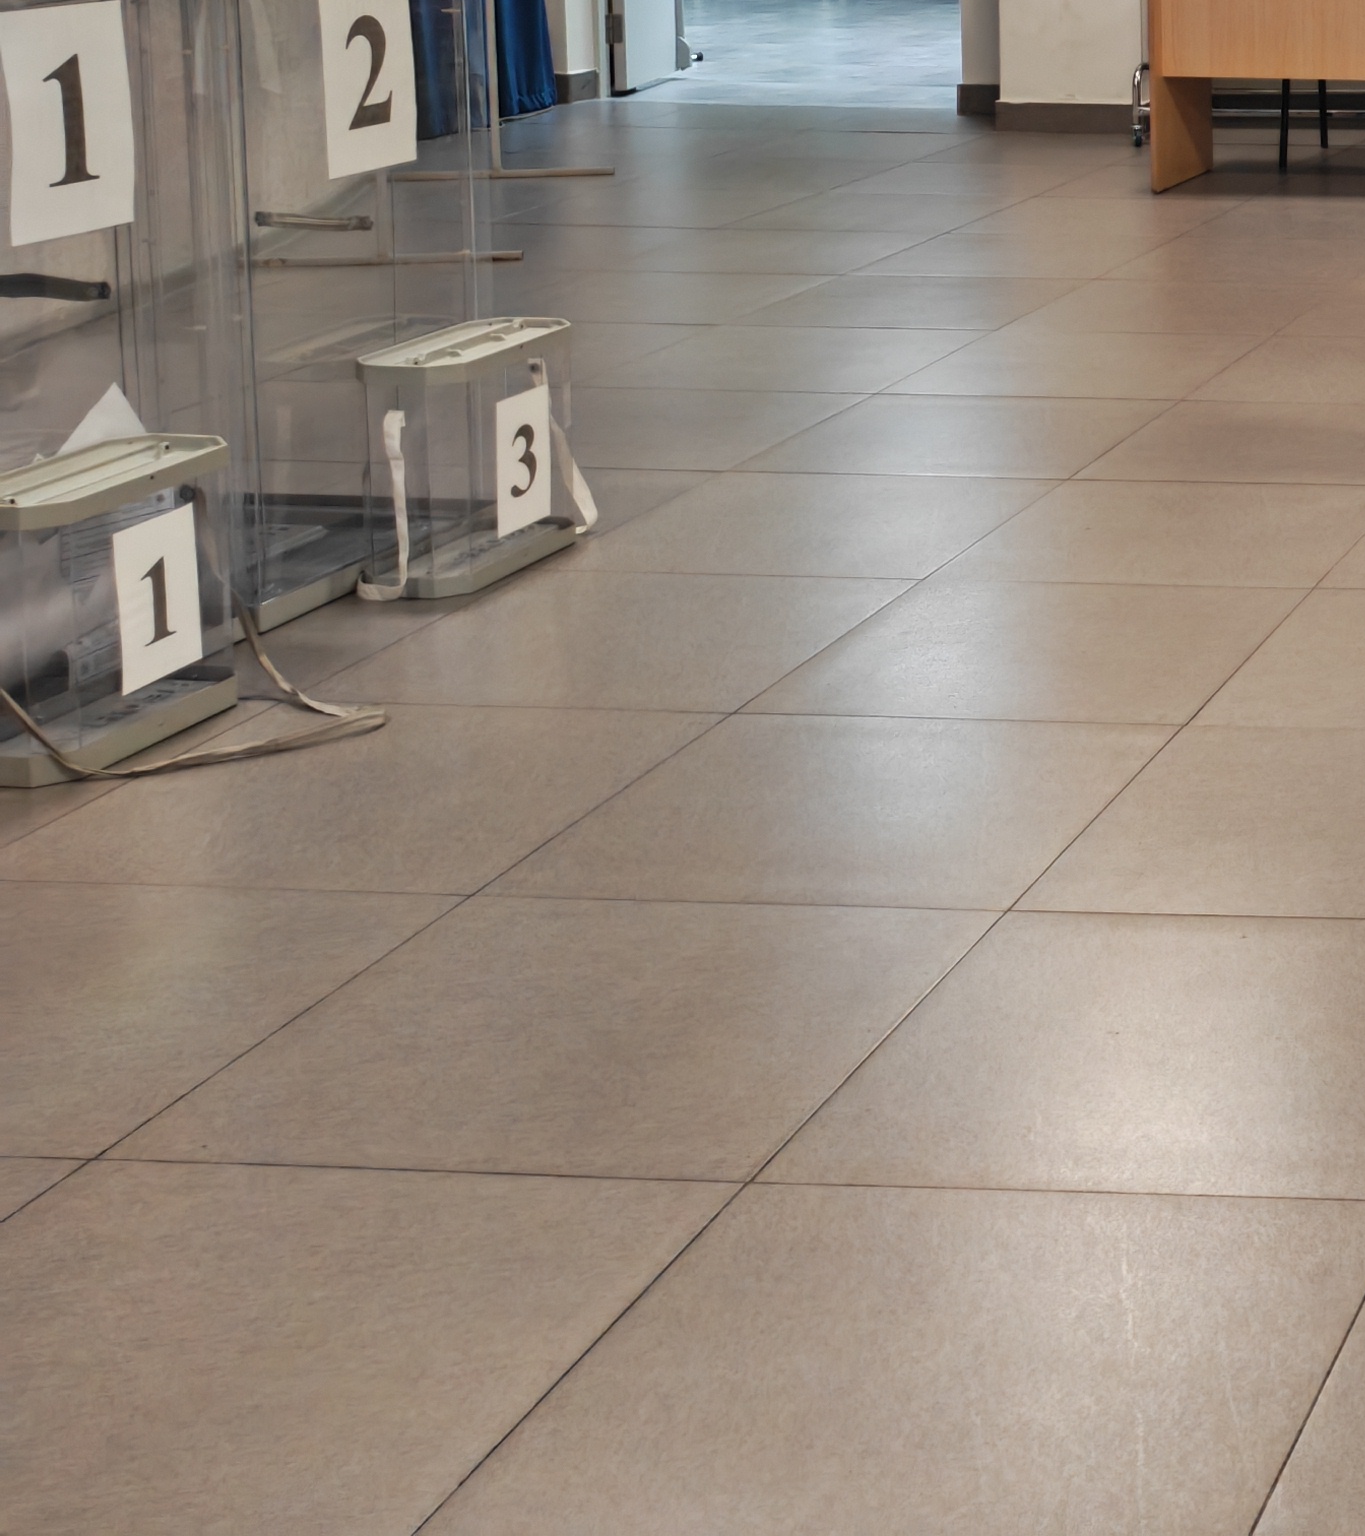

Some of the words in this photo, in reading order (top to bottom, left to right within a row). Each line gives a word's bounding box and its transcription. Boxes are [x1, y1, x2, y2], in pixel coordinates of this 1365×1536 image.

[42, 52, 101, 189] 1
[344, 14, 393, 131] 2
[510, 422, 538, 498] 3
[140, 555, 178, 648] 1
